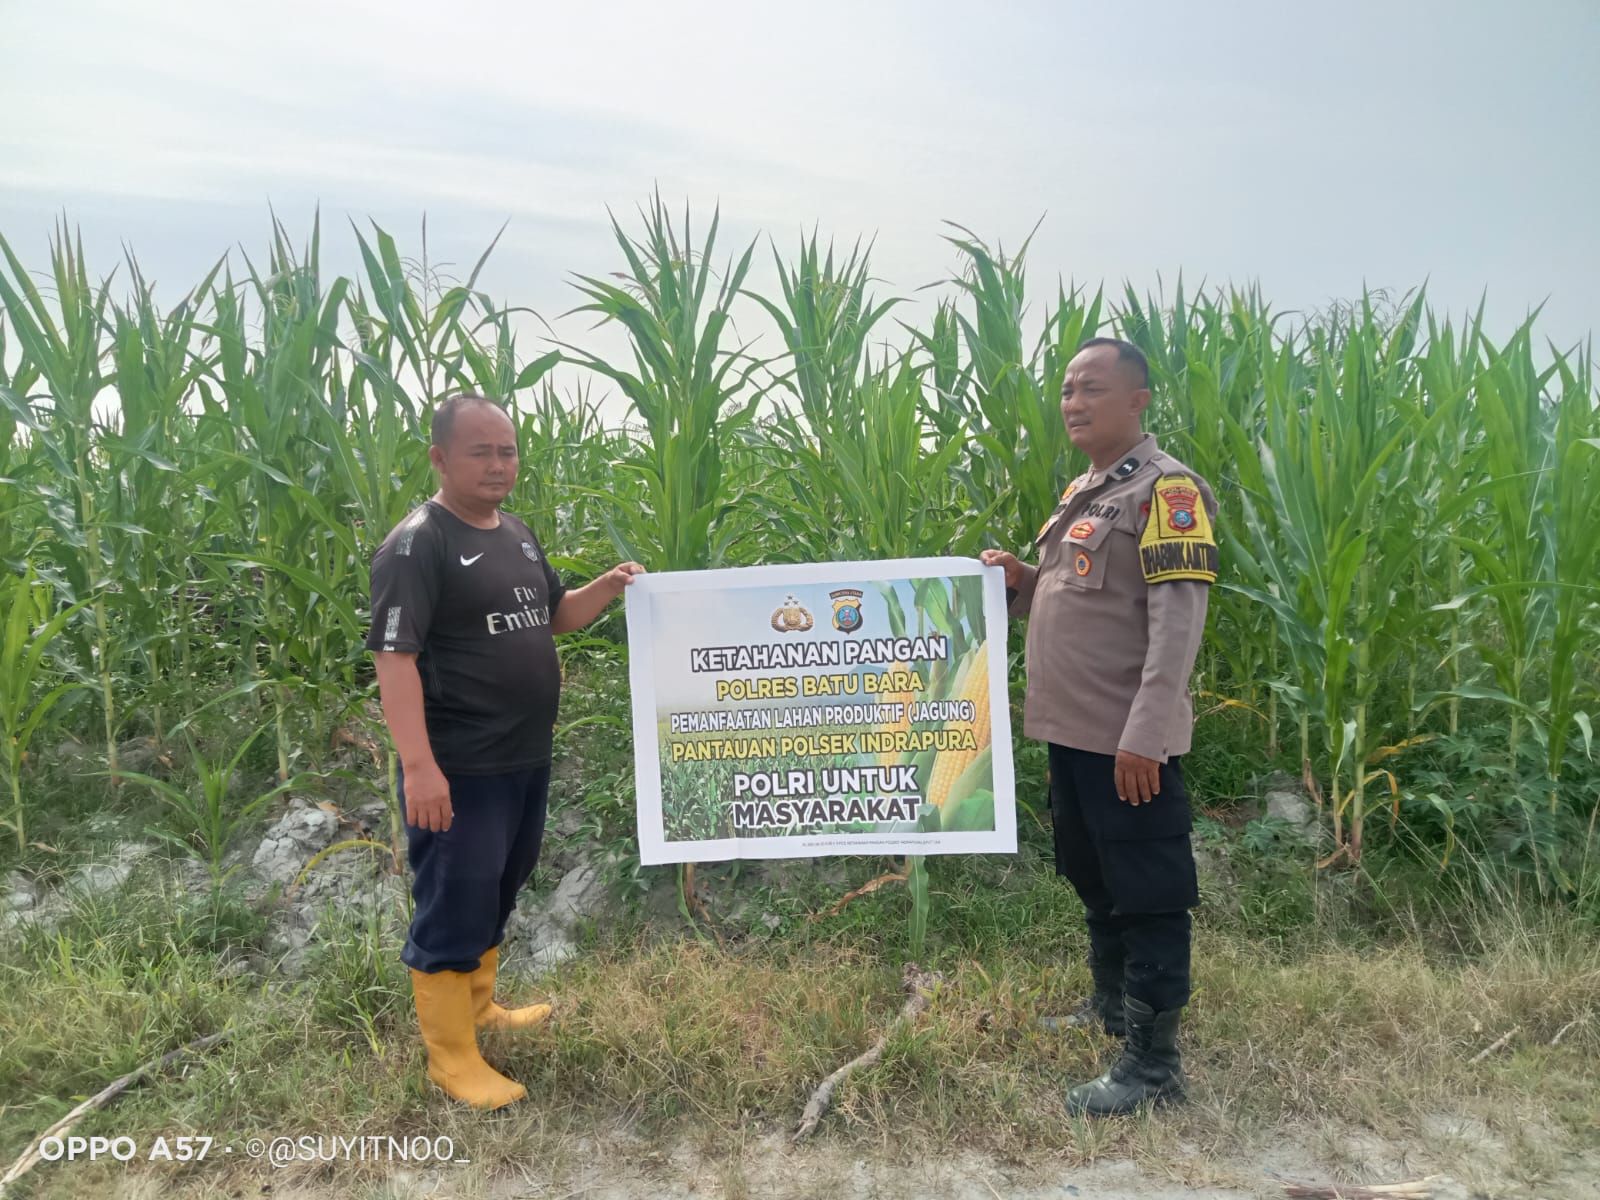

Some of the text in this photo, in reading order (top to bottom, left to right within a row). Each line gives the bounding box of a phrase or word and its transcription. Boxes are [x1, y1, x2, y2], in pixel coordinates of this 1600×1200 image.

[1081, 503, 1120, 520] POLRI
[691, 636, 947, 672] KETAHANAN PANGAN
[717, 672, 924, 701] POLRES BATU BARA
[671, 701, 976, 733] PEMANFAATAN LAHAN PRODUKTIF (JAGUNG)
[672, 730, 976, 761] PANTAUAN POLSEK INDRAPURA
[734, 767, 919, 797] POLRI UNTUK
[734, 799, 920, 828] MASYARAKAT
